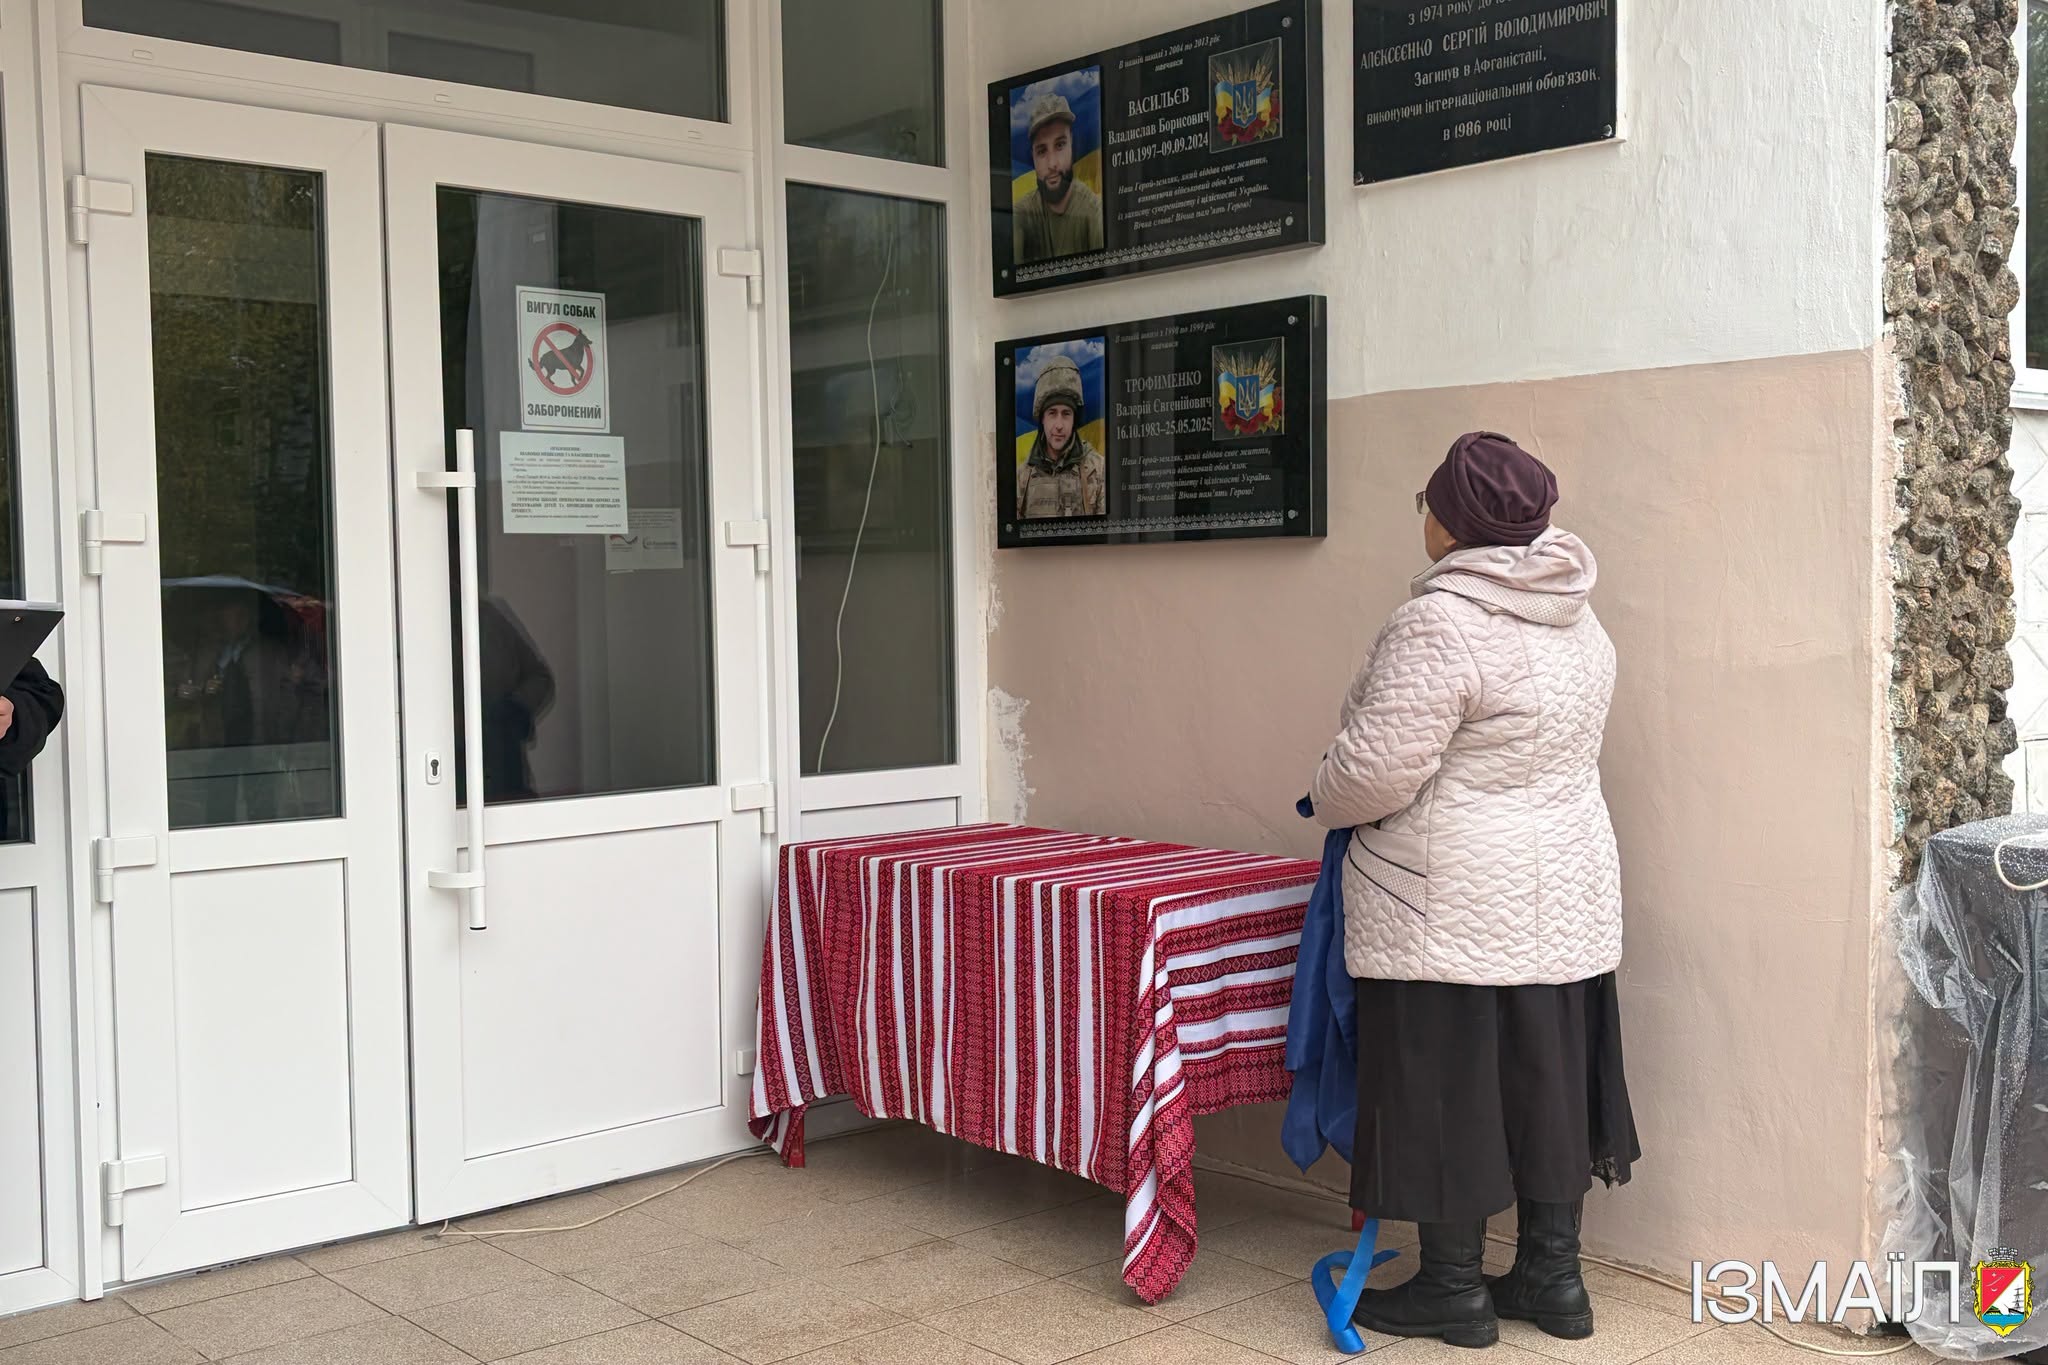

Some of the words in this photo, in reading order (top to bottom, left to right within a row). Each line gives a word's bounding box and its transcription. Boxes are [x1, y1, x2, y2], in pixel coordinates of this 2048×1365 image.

[1408, 13, 1416, 26] з
[1419, 4, 1443, 23] 1974
[1442, 21, 1488, 52] СЕРГІЙ
[1494, 1, 1608, 41] ВОЛОДИМИРОВИЧ
[1169, 44, 1184, 56] 2004
[1184, 44, 1193, 52] по
[1194, 36, 1209, 48] 2013
[1414, 66, 1460, 87] Загинув
[1464, 64, 1470, 76] в
[1128, 86, 1190, 118] ВАСИЛЬЄВ
[1366, 101, 1422, 126] виконуючи
[1424, 79, 1533, 114] інтернаціональний
[1108, 124, 1156, 145] Владислав
[1158, 110, 1210, 134] Борисович
[1443, 128, 1450, 141] в
[1454, 120, 1482, 139] 1986
[1486, 113, 1512, 133] році
[1118, 186, 1133, 194] Наш
[526, 300, 560, 316] ВИГУЛ
[563, 304, 596, 318] СОБАК
[1125, 370, 1202, 394] ТРОФИМЕНКО
[527, 403, 602, 420] ЗАБОРОНЕНИЙ
[1116, 400, 1150, 418] Валерій
[1153, 395, 1212, 414] Євгенійович
